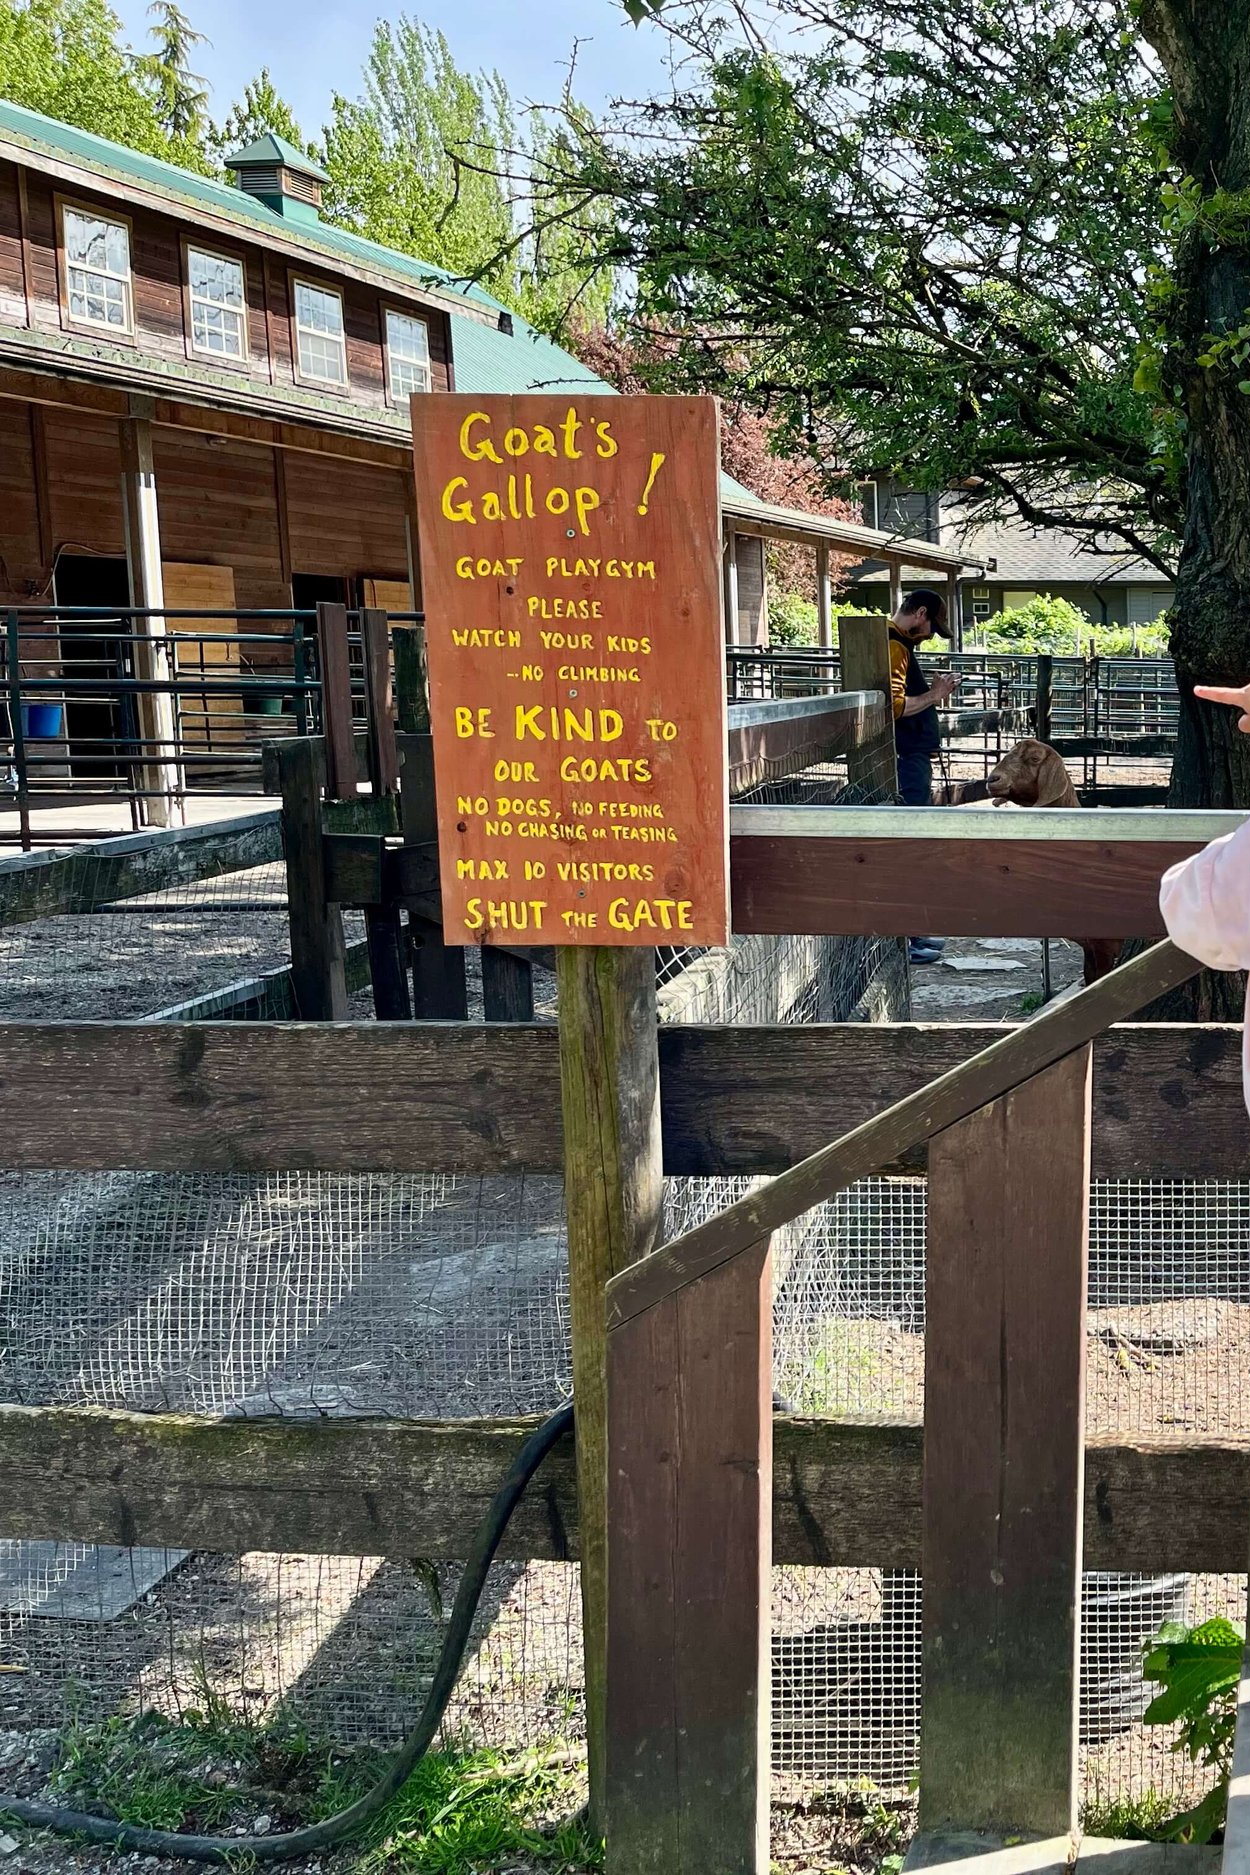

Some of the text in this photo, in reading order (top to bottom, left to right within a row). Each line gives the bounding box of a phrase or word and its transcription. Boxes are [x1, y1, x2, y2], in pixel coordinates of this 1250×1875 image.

[459, 406, 618, 464] Goat's
[455, 556, 524, 580] GOAT
[527, 596, 603, 619] PLEASE
[451, 628, 651, 655] WATCH YOUR KIDS
[557, 665, 641, 683] CLIMBING
[454, 704, 678, 743] BE KIND TO
[493, 756, 653, 783] OUR GOATS
[456, 795, 664, 820] NO DOGS, NO FEEDING
[485, 820, 513, 837] NO
[517, 821, 588, 842] CHASING
[610, 825, 678, 843] TEASING
[455, 859, 653, 883] MAX 10 VISITORS
[463, 897, 694, 933] SHUT THE GATE
